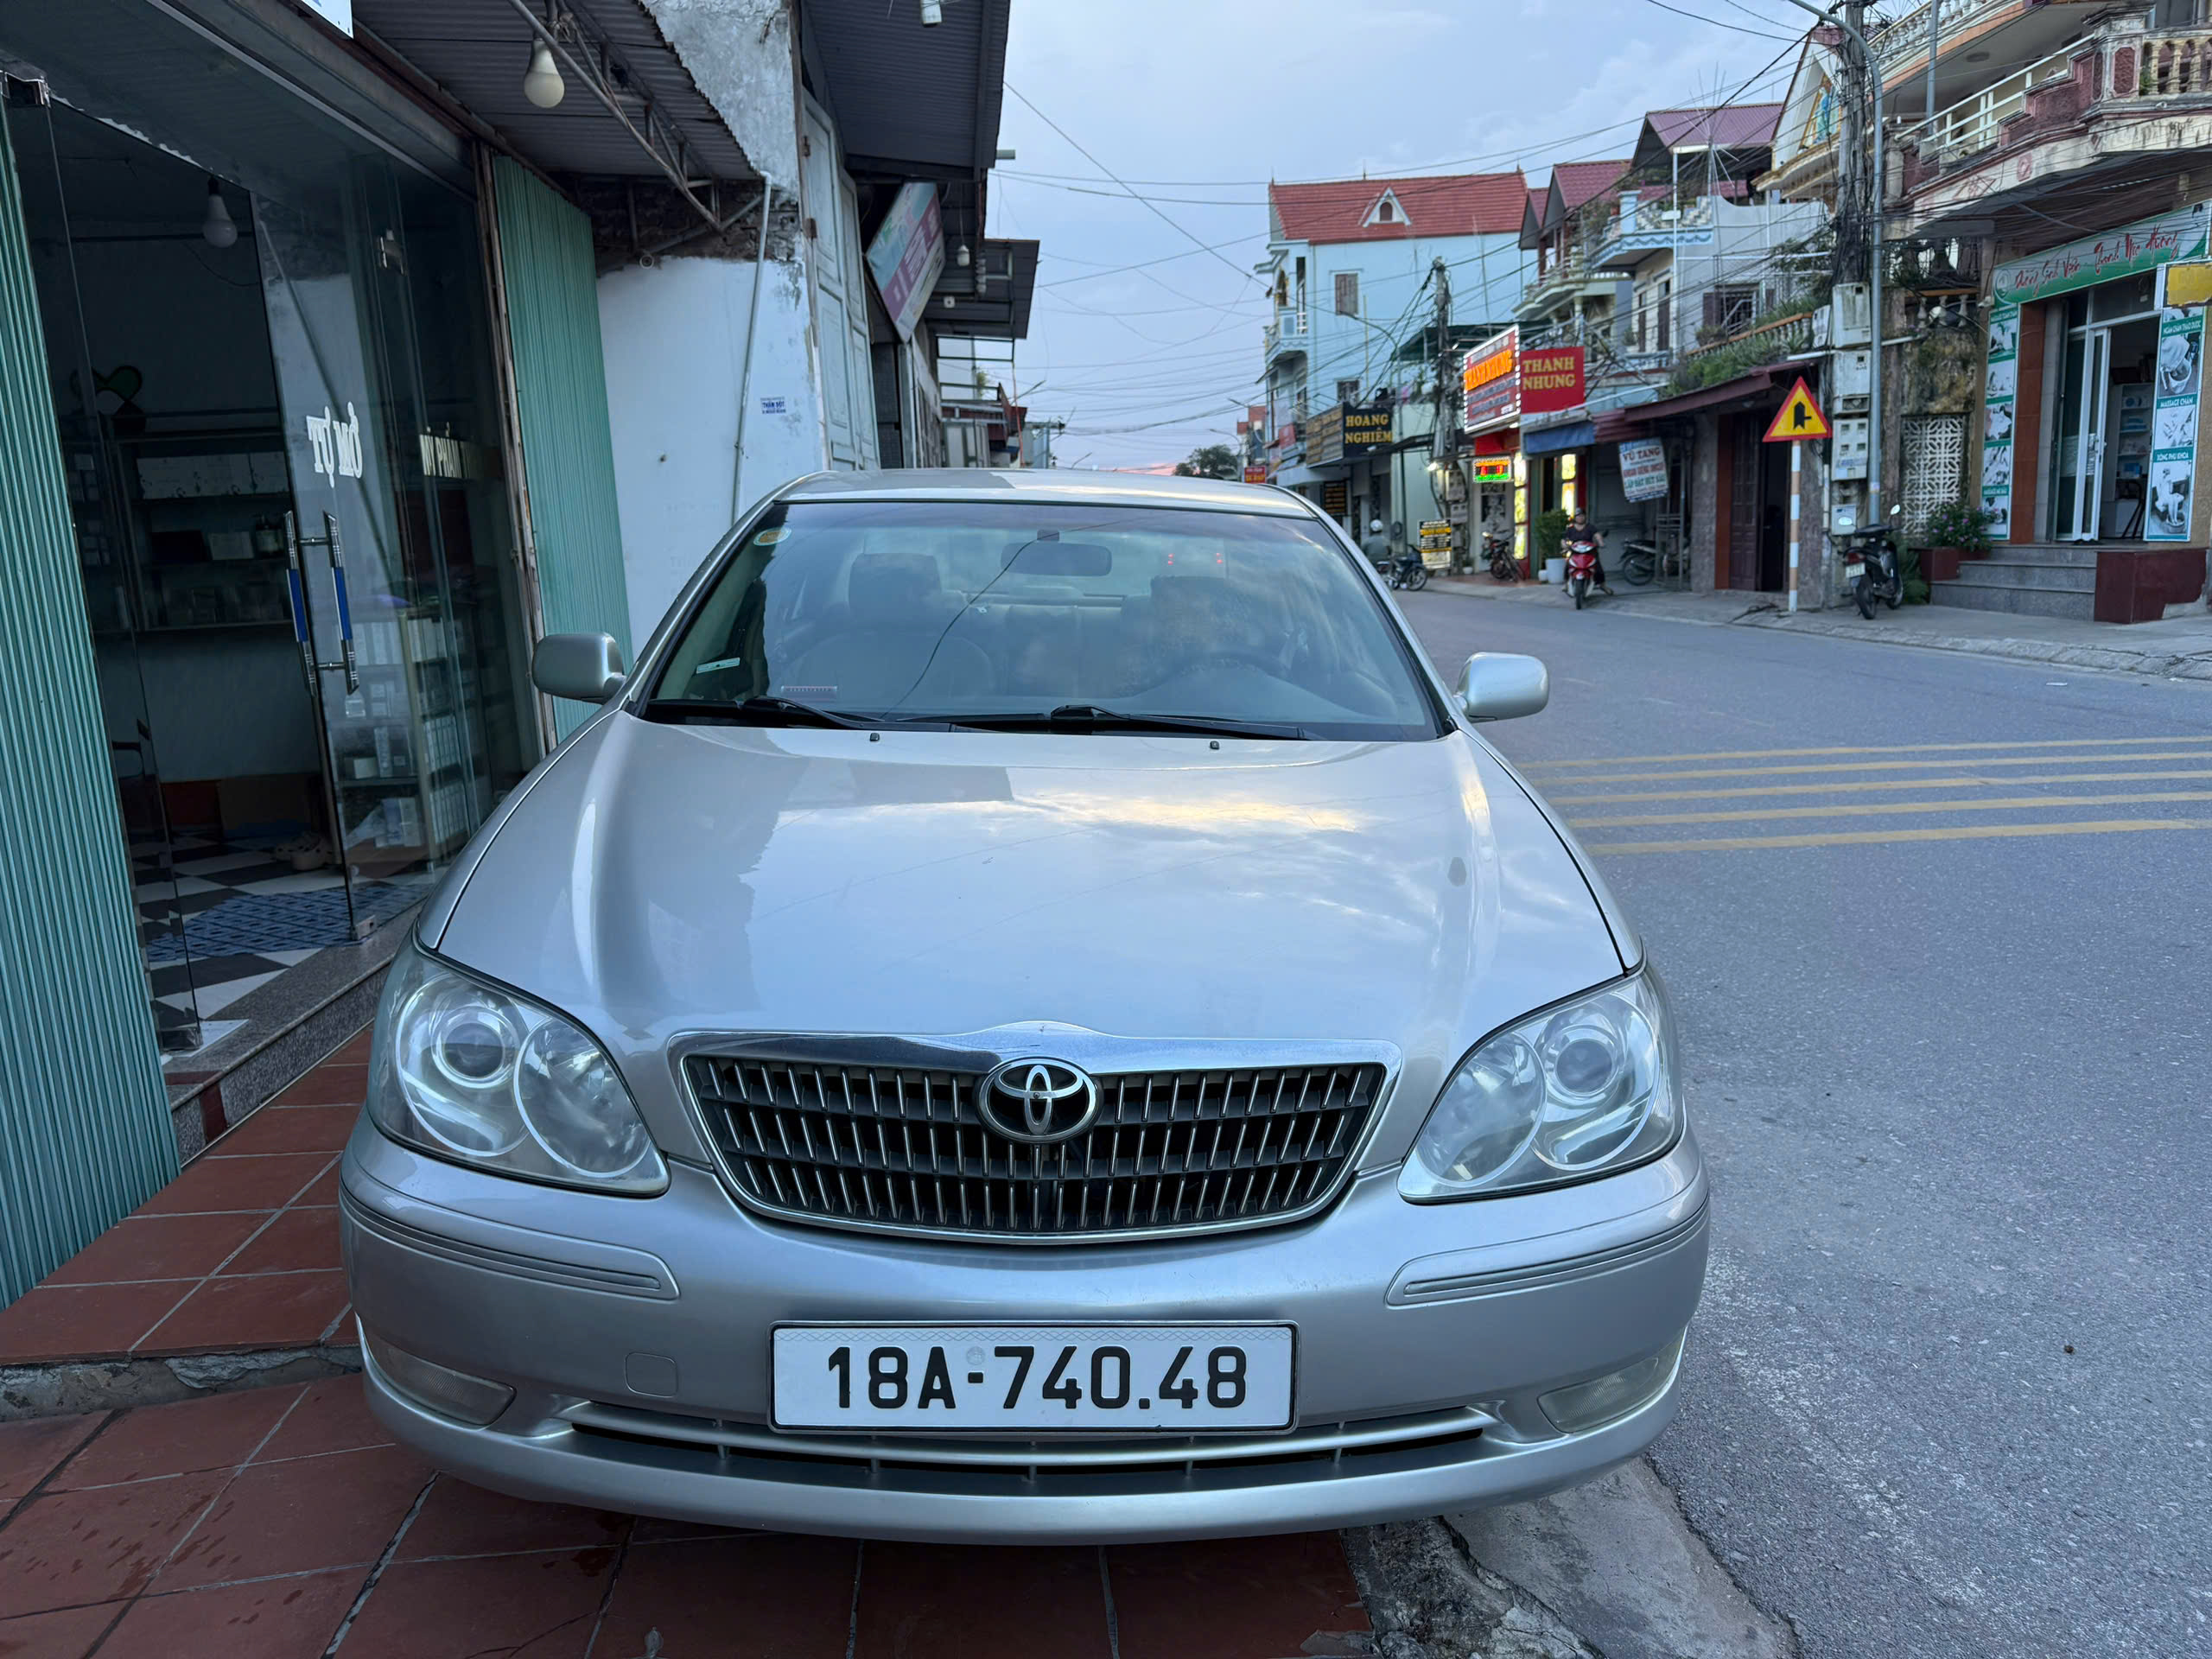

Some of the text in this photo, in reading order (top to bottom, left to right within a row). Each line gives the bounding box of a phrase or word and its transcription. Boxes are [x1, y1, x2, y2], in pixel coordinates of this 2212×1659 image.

[1522, 357, 1574, 373] THANH
[1522, 374, 1575, 390] NHUNG
[2160, 399, 2179, 408] MASSAGE
[1345, 414, 1389, 427] HOANG
[1344, 429, 1393, 444] NGHIÊM
[829, 1345, 1247, 1409] 18A-740.48
